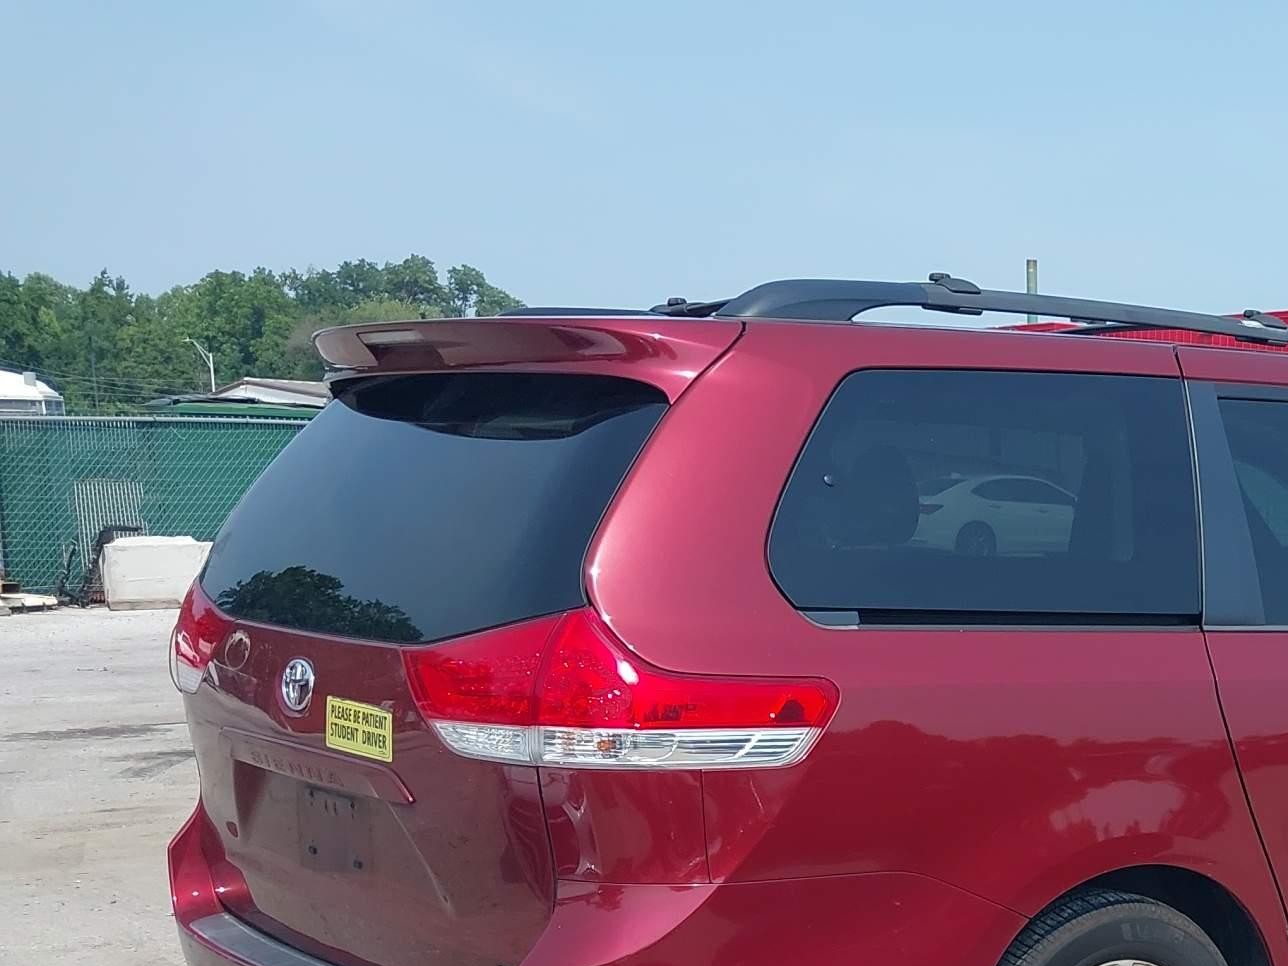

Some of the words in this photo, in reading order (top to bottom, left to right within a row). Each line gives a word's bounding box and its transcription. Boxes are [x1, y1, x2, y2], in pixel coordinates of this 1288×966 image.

[330, 704, 352, 722] PLEASE
[352, 709, 361, 725] BE
[361, 711, 388, 731] PATIENT
[330, 722, 359, 743] STUDENT
[361, 729, 387, 750] DRIVER
[250, 751, 345, 788] SIENNA
